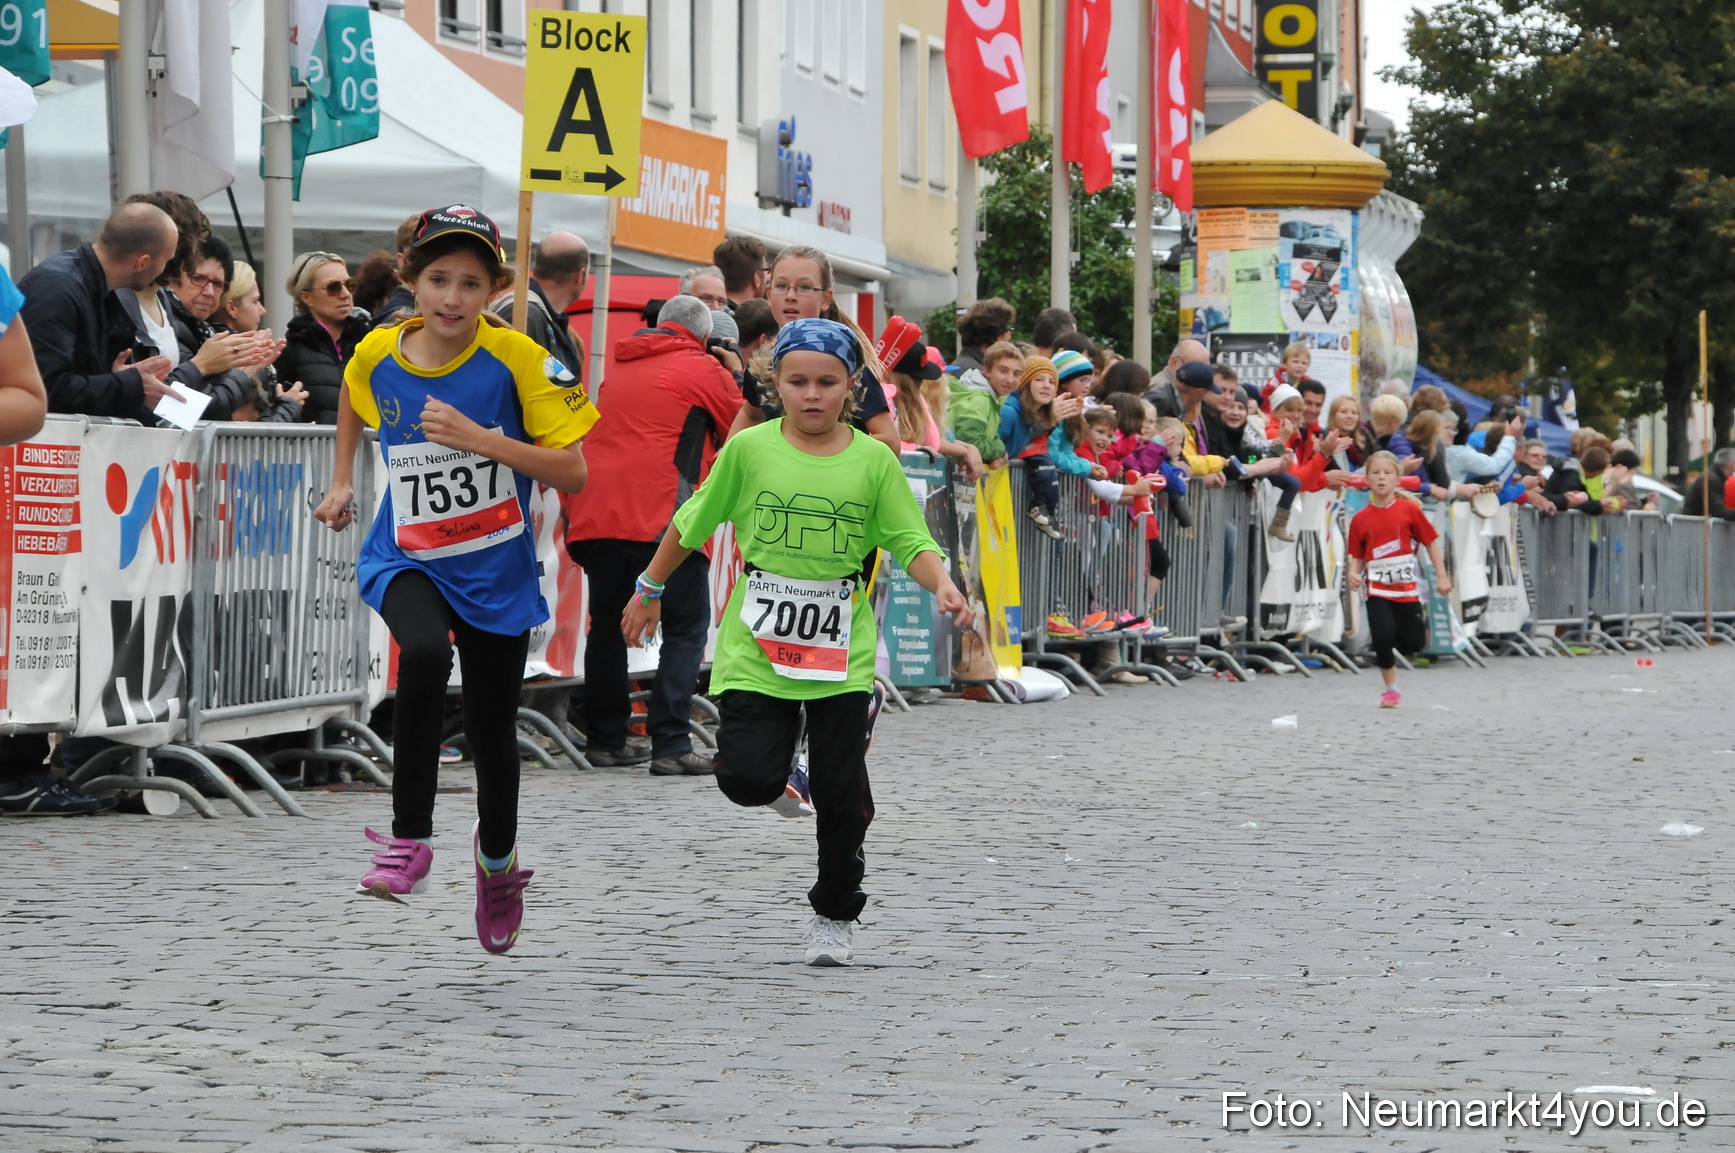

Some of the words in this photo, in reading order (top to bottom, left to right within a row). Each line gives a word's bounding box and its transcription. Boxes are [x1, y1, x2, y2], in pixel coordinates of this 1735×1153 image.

[0, 3, 46, 49] 91
[541, 17, 631, 53] Block
[546, 66, 614, 155] A
[432, 213, 490, 231] Deutschland
[390, 456, 424, 469] PARTL
[425, 450, 477, 466] Neumar
[400, 460, 500, 517] 7537
[438, 523, 481, 540] Selina
[17, 570, 43, 586] Braun
[1375, 567, 1413, 583] 7113
[16, 590, 28, 605] Am
[749, 580, 782, 594] PARTL
[785, 585, 835, 599] Neumarkt
[16, 609, 49, 624] D-92318
[752, 597, 841, 642] 7004
[15, 635, 26, 650] Tel.
[15, 655, 26, 669] Fax
[777, 646, 803, 664] Eva
